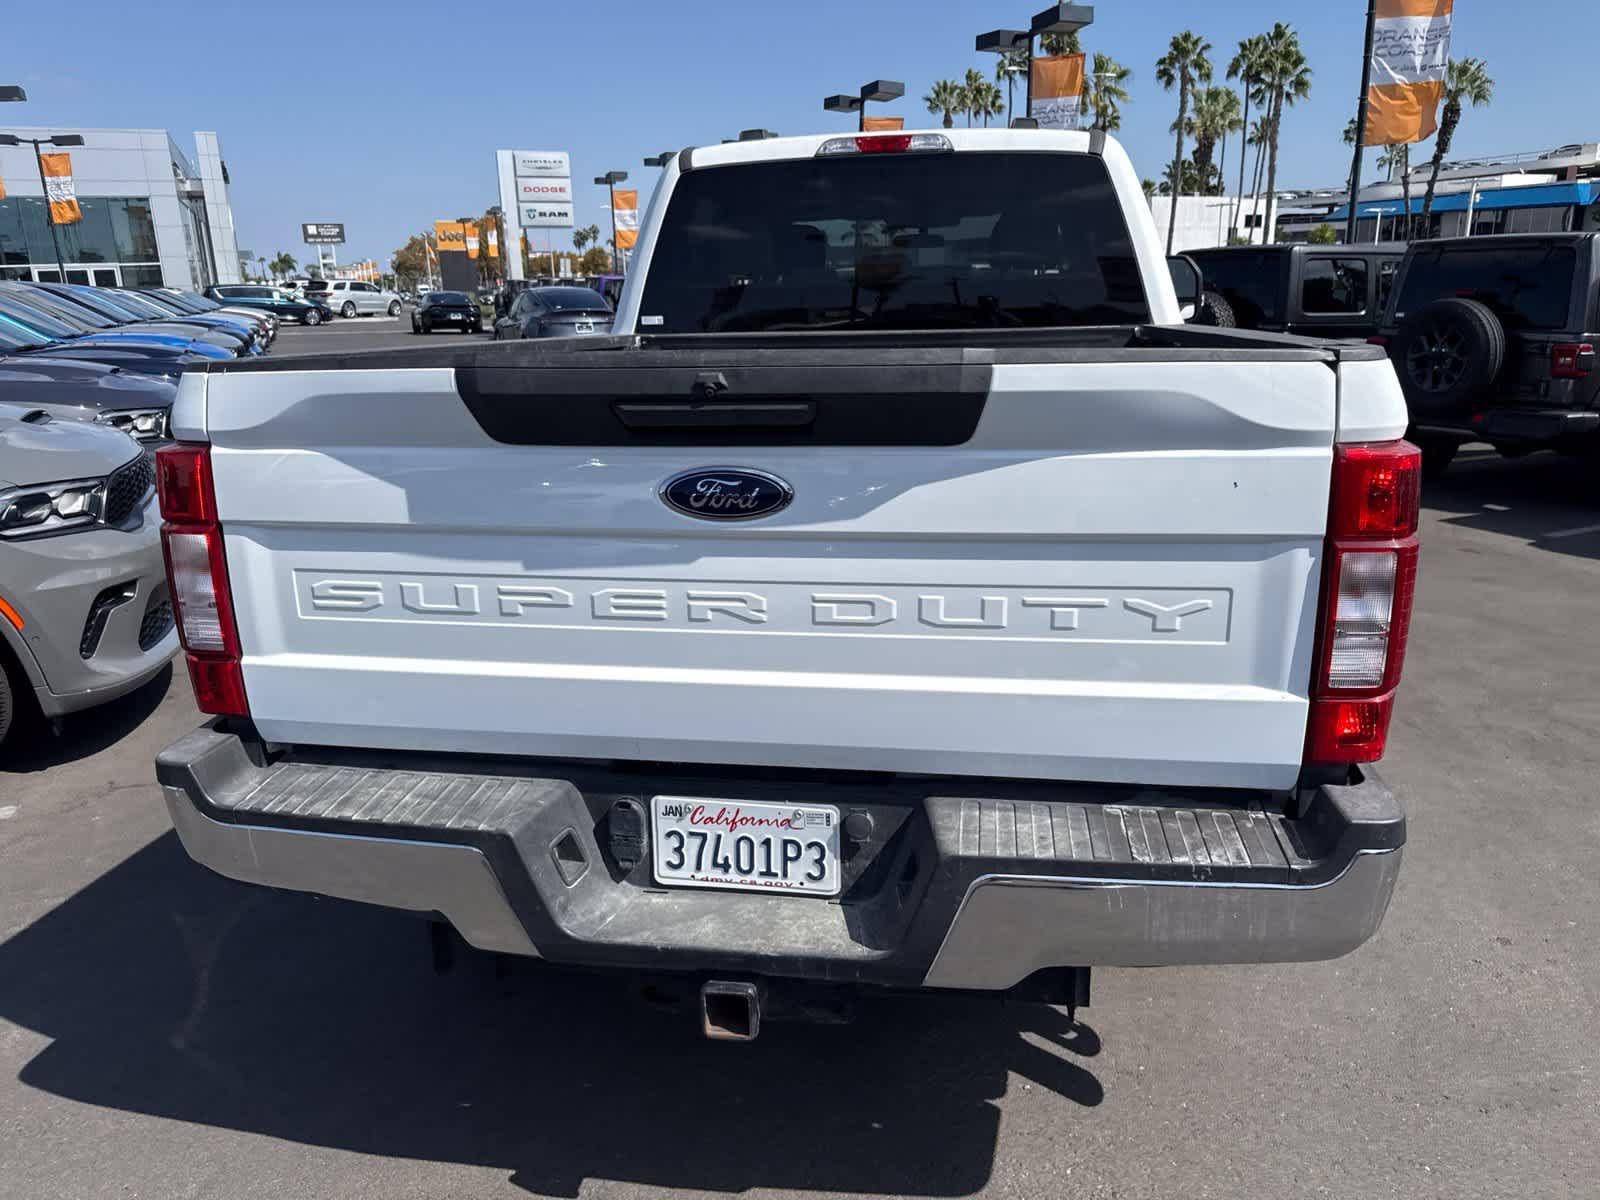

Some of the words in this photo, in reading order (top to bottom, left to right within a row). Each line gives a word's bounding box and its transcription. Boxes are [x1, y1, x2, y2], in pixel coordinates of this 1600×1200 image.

[1375, 42, 1441, 56] COAST
[690, 479, 759, 508] Ford
[312, 580, 768, 623] SUPER
[811, 594, 1213, 633] DUTY
[662, 804, 683, 817] JAN
[690, 805, 793, 832] California
[664, 830, 827, 881] 37401P3
